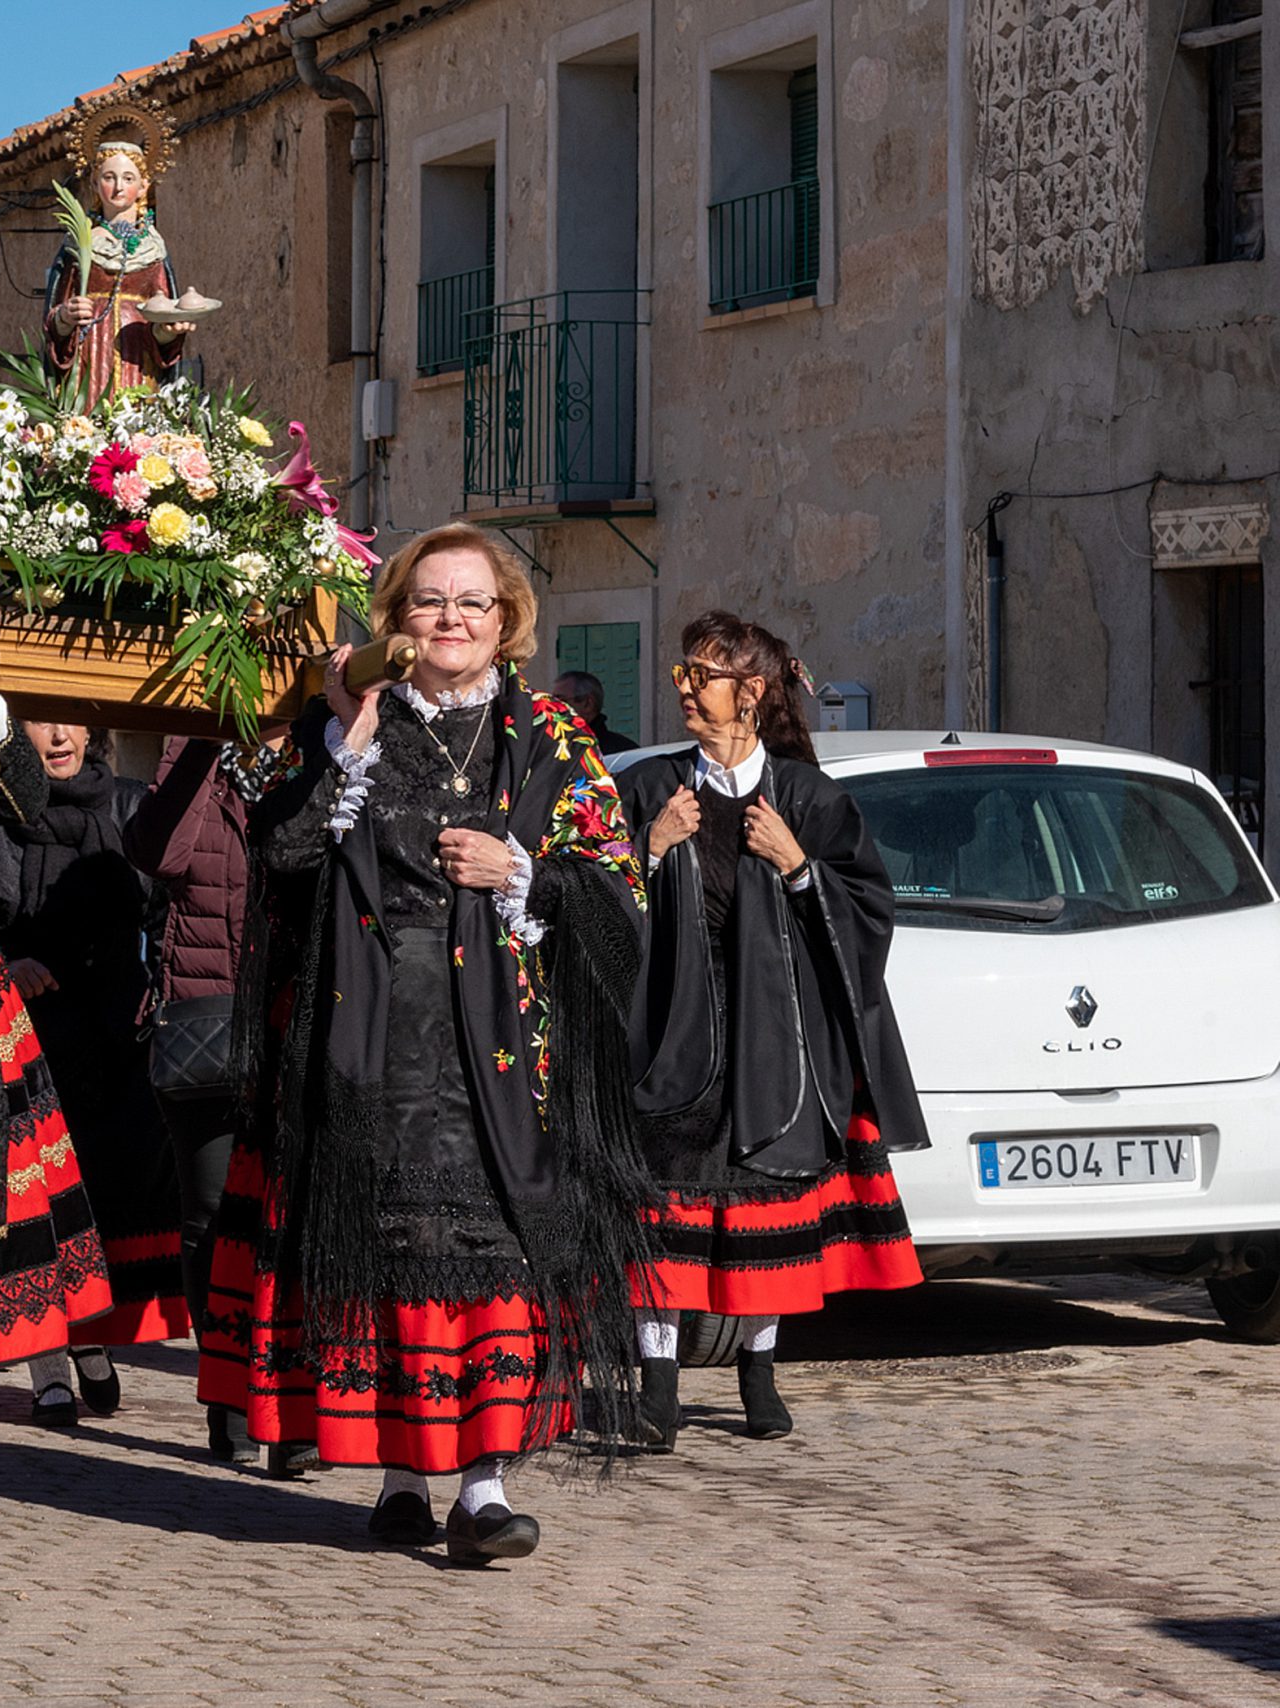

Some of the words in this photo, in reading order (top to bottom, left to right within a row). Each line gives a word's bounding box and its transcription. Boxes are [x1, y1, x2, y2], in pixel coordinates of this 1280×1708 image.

[1042, 1037, 1122, 1053] CLIO
[1006, 1142, 1102, 1181] 2604
[1117, 1139, 1183, 1176] FTV
[986, 1168, 995, 1179] E
